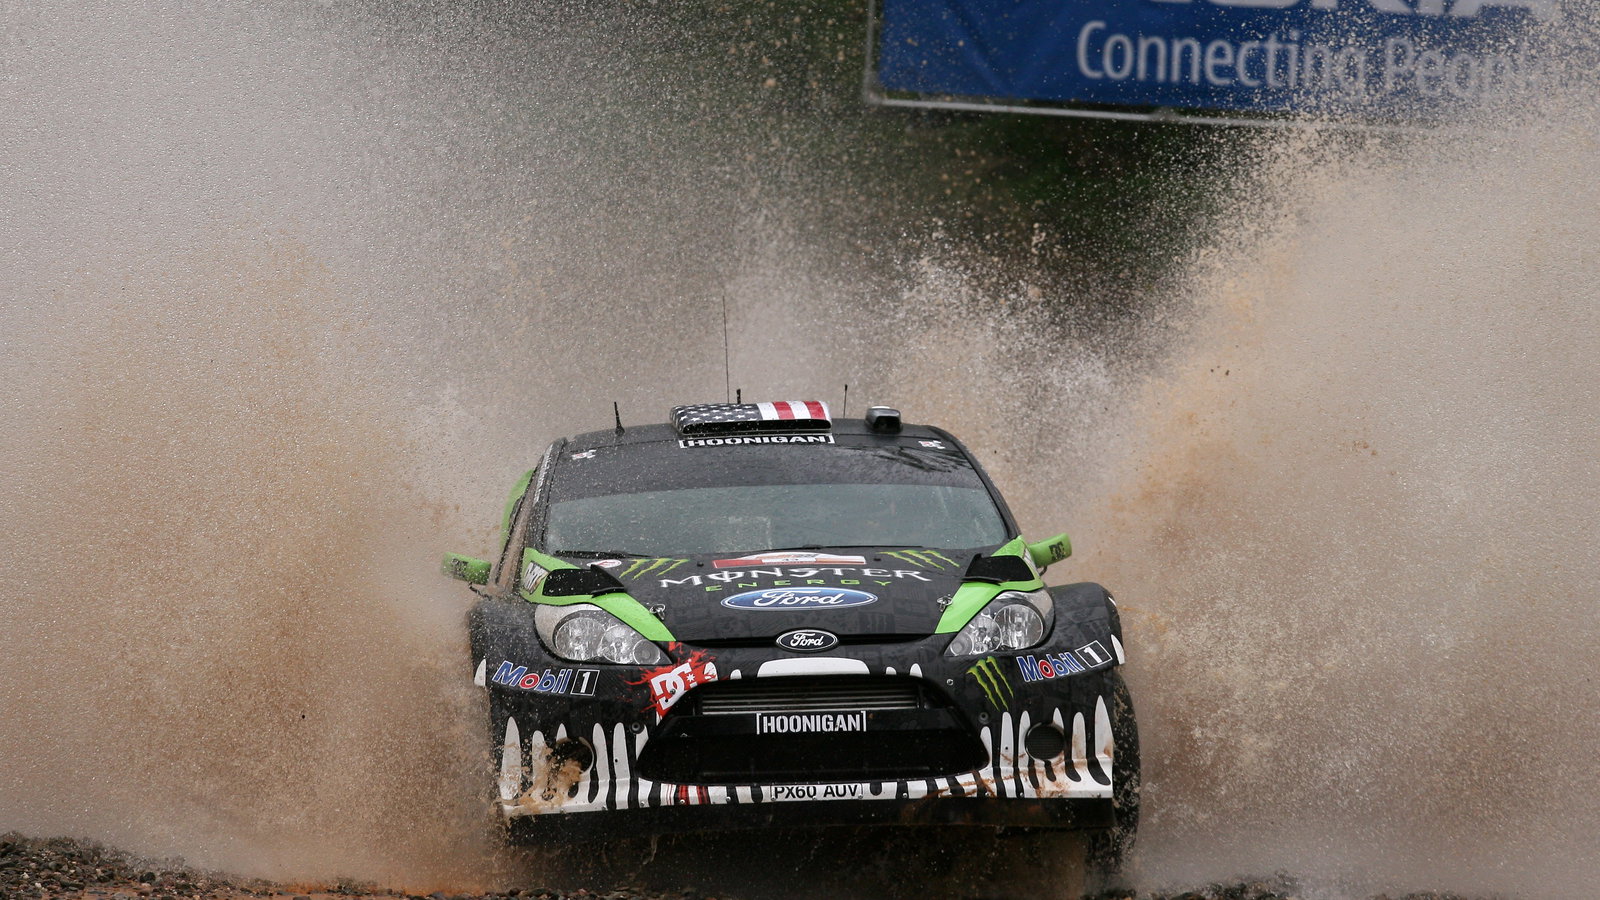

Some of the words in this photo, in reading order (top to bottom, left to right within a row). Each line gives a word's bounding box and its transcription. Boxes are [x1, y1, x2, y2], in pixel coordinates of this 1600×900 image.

[1076, 19, 1367, 91] Connecting
[1385, 36, 1550, 101] Peop
[705, 579, 892, 592] ENERGY
[753, 589, 846, 606] Ford
[789, 632, 824, 647] Ford
[1016, 652, 1085, 682] Mobil
[491, 660, 573, 694] Mobil
[774, 785, 817, 799] PX60
[823, 784, 858, 798] AUV
